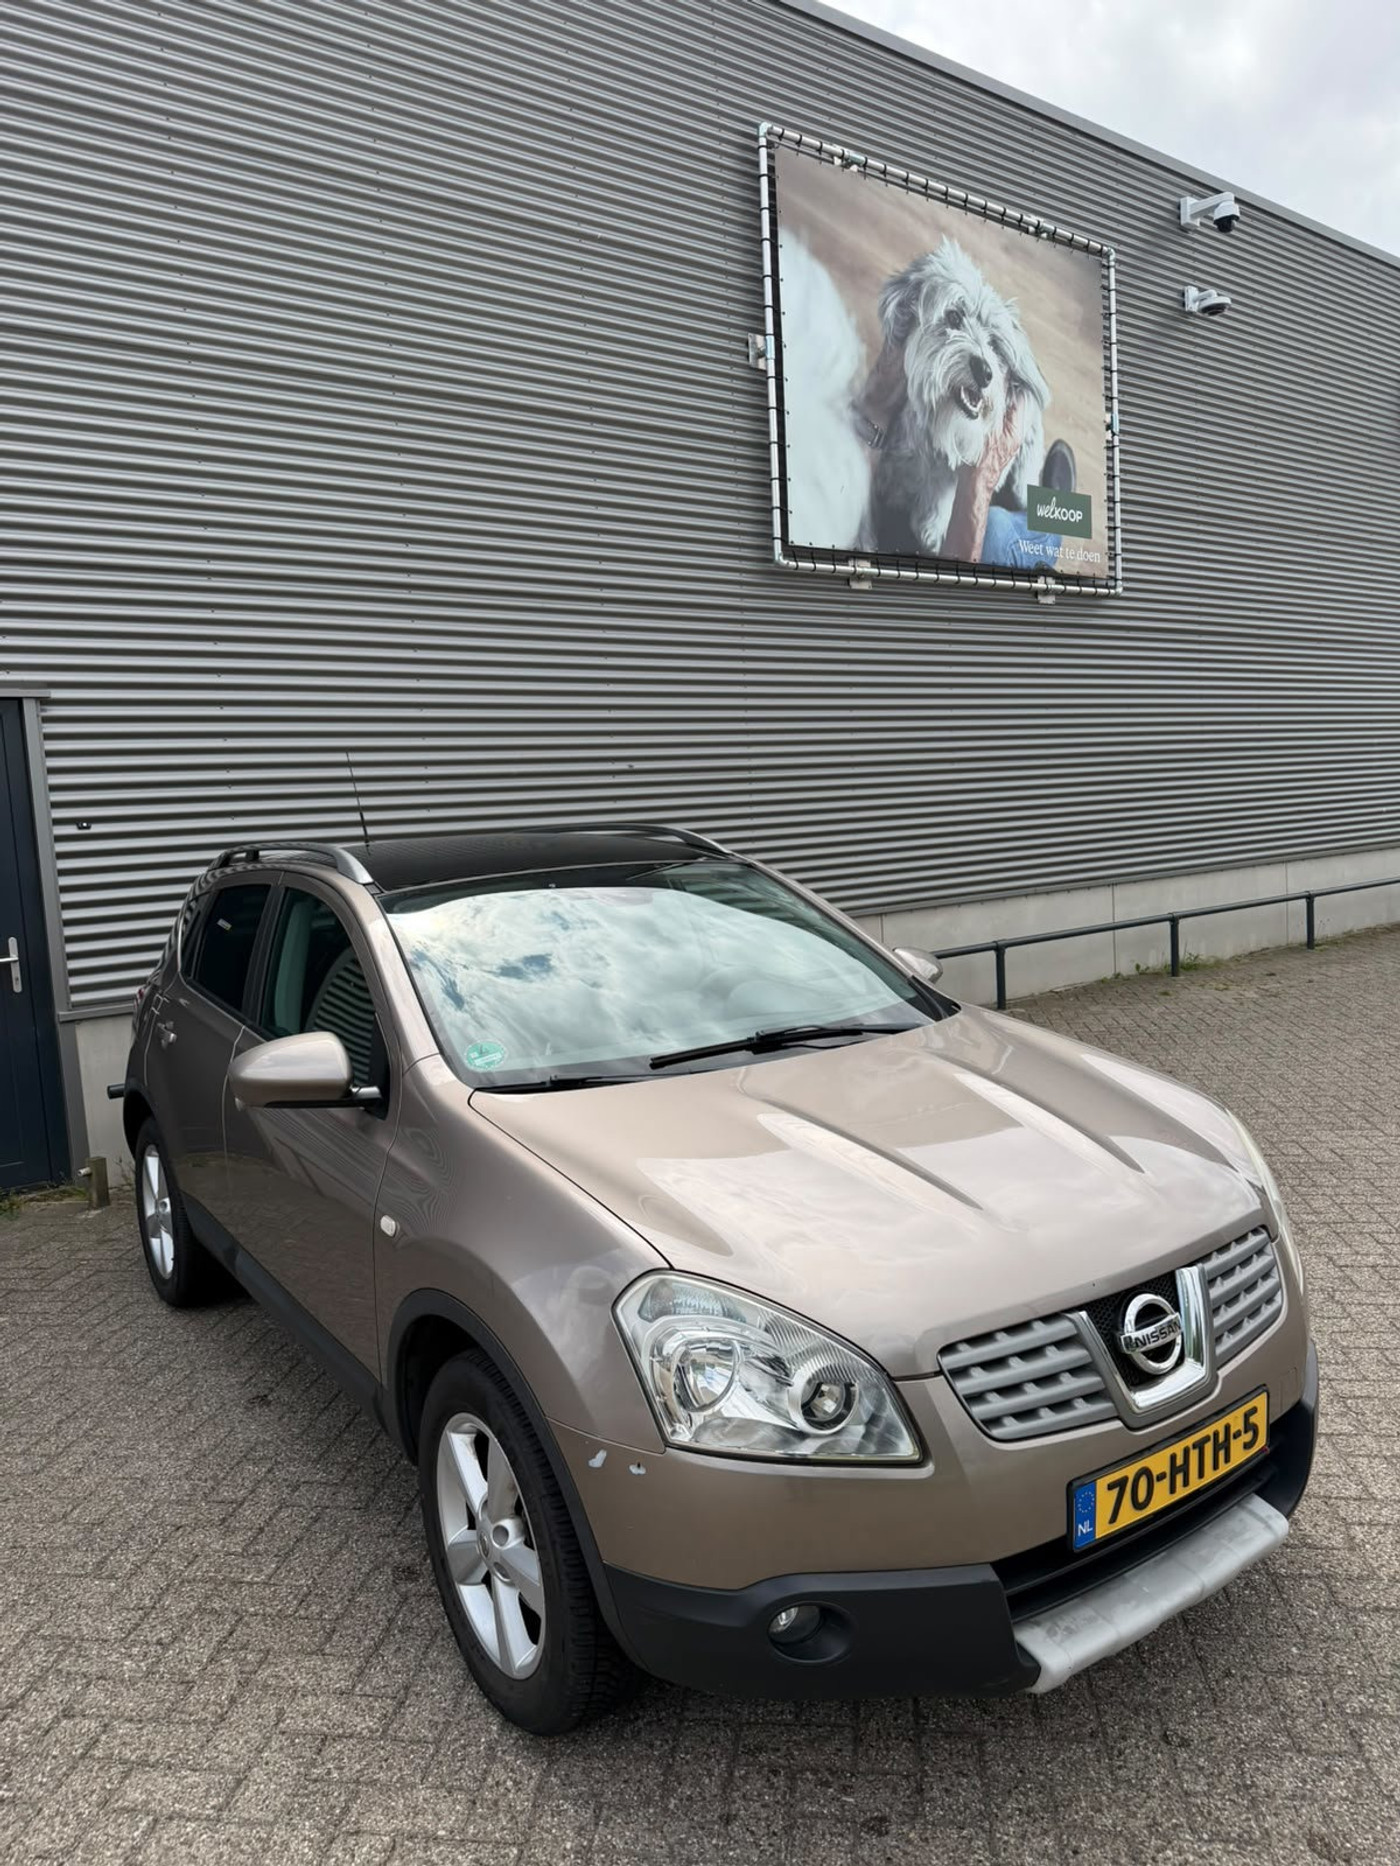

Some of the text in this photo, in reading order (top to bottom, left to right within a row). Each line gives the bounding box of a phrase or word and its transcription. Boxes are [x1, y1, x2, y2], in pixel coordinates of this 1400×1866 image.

[1019, 539, 1101, 563] Weet wat te doen
[1133, 1320, 1181, 1349] NISSAN
[1107, 1406, 1259, 1525] 70-HTH-5
[1078, 1519, 1093, 1537] NL
